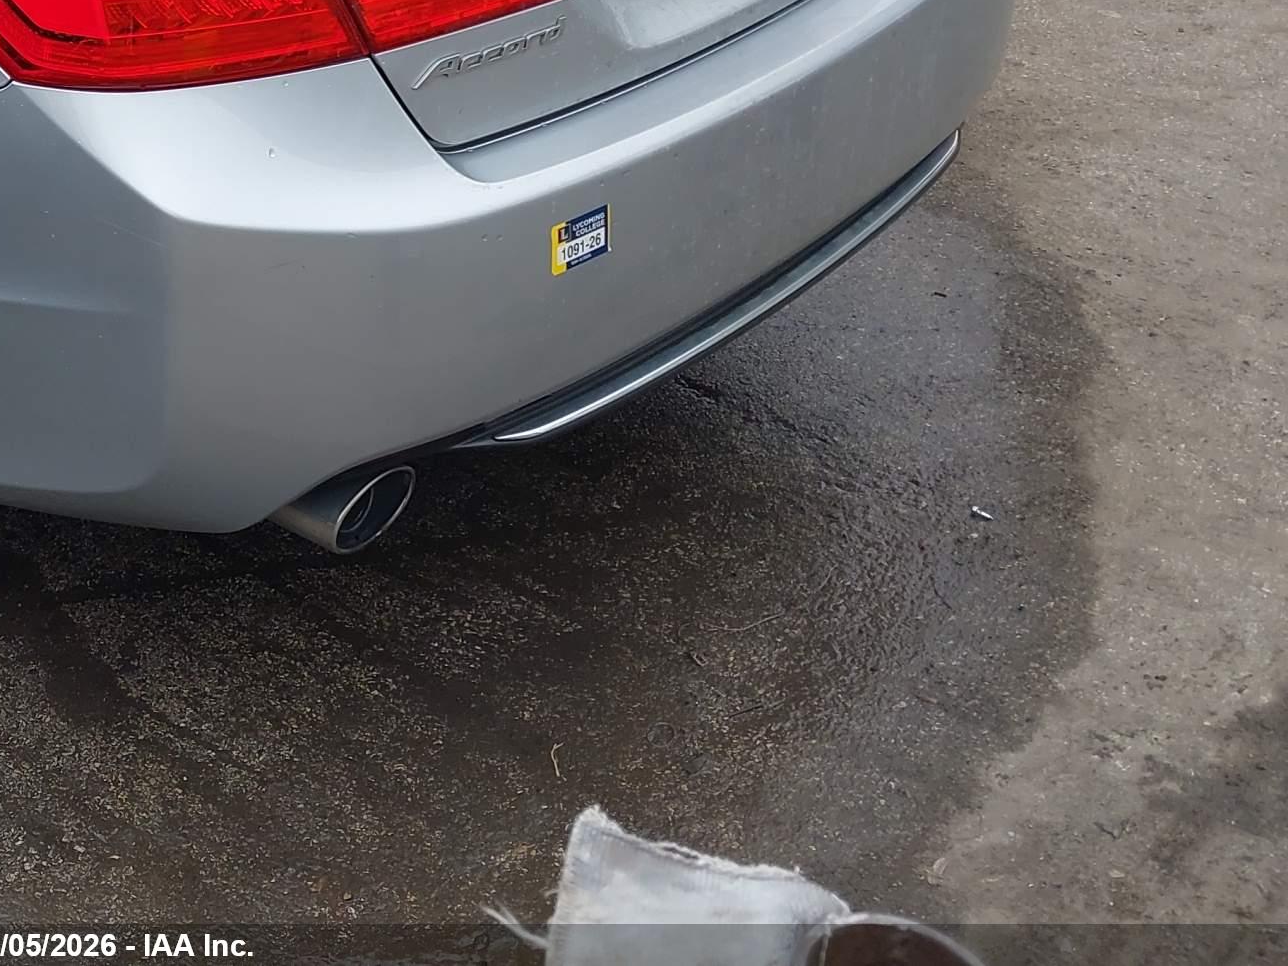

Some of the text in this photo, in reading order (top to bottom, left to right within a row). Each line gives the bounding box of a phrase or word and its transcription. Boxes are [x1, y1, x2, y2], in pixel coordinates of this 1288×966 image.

[411, 14, 567, 90] Accord
[572, 212, 606, 232] LYCOMING
[575, 219, 606, 237] COLLEGE
[561, 233, 602, 261] 1091-26
